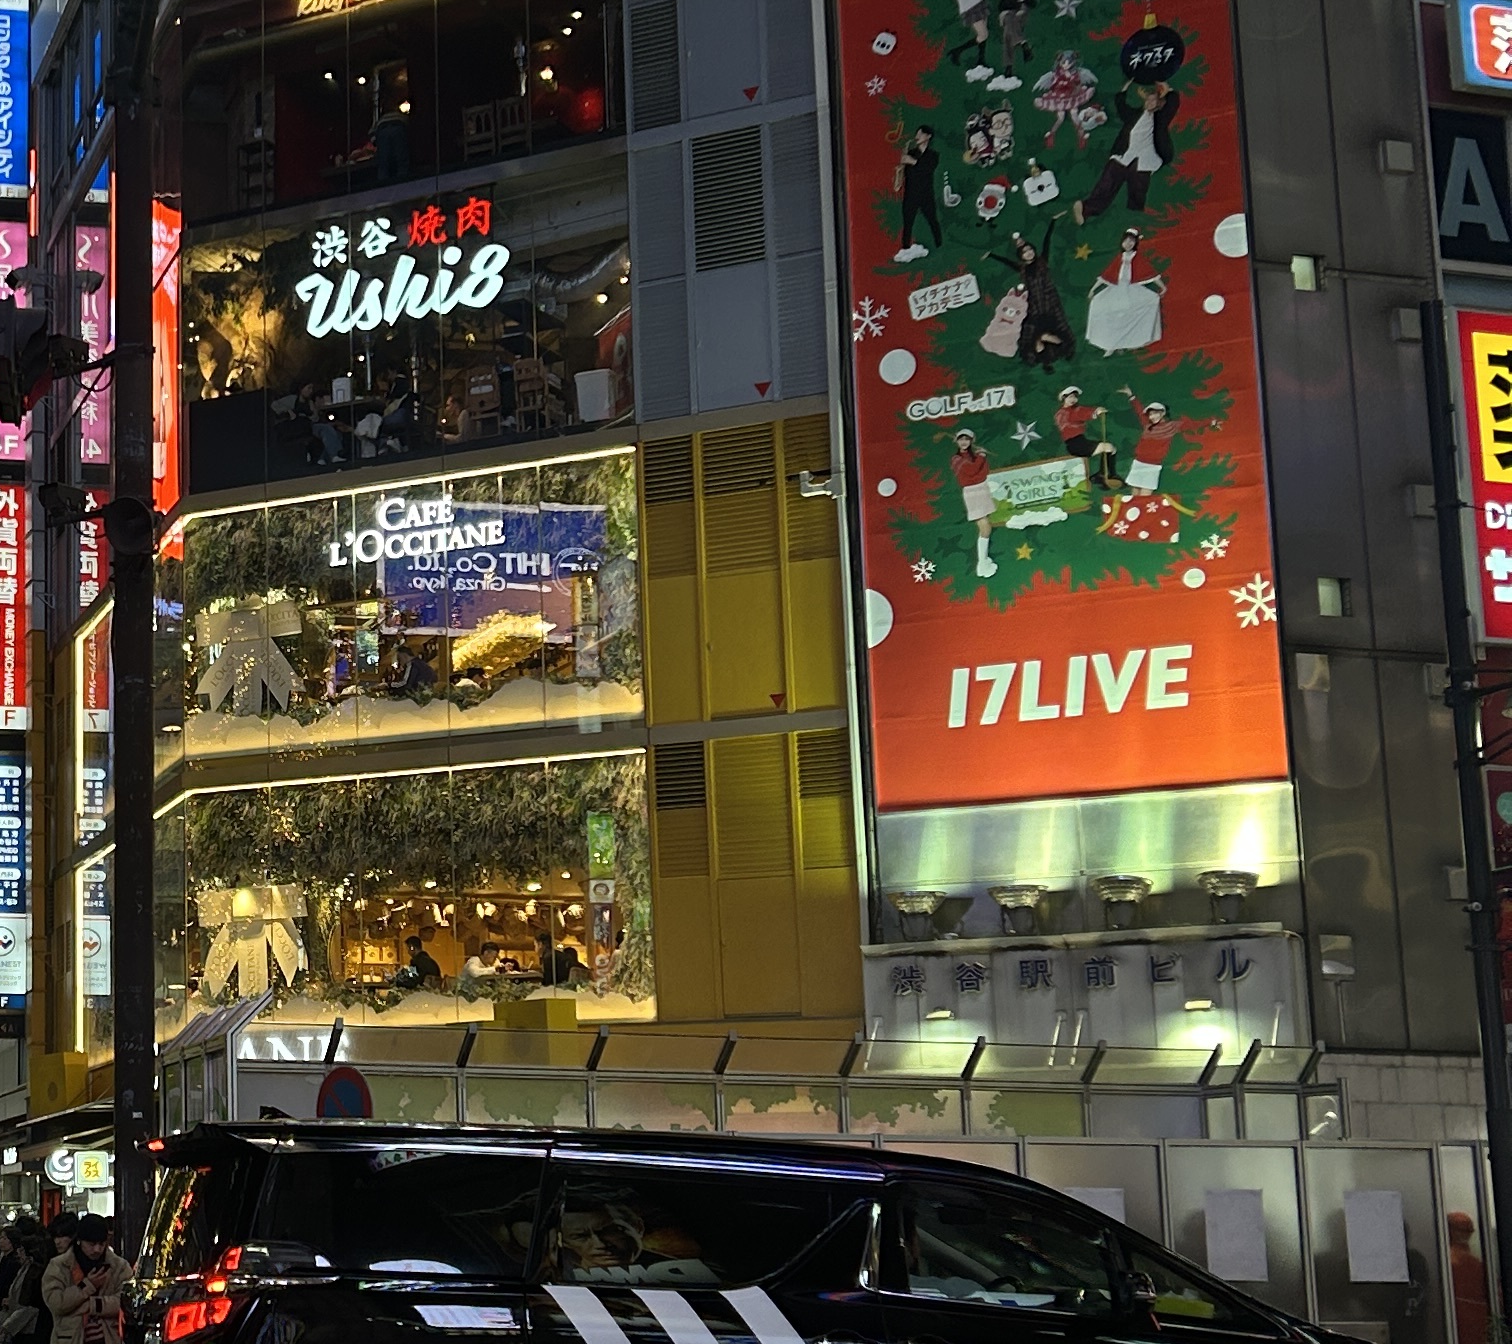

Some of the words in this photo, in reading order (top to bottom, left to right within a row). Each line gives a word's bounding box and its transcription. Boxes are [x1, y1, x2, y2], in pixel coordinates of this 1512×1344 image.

[295, 244, 510, 338] Ushi8
[915, 292, 976, 318] アカデミー
[909, 393, 972, 419] GOLF
[1011, 471, 1062, 490] SWING
[1015, 486, 1058, 502] GIRLS
[947, 643, 1192, 729] 17LIVE
[891, 947, 1253, 996] 渋谷駅前ビル
